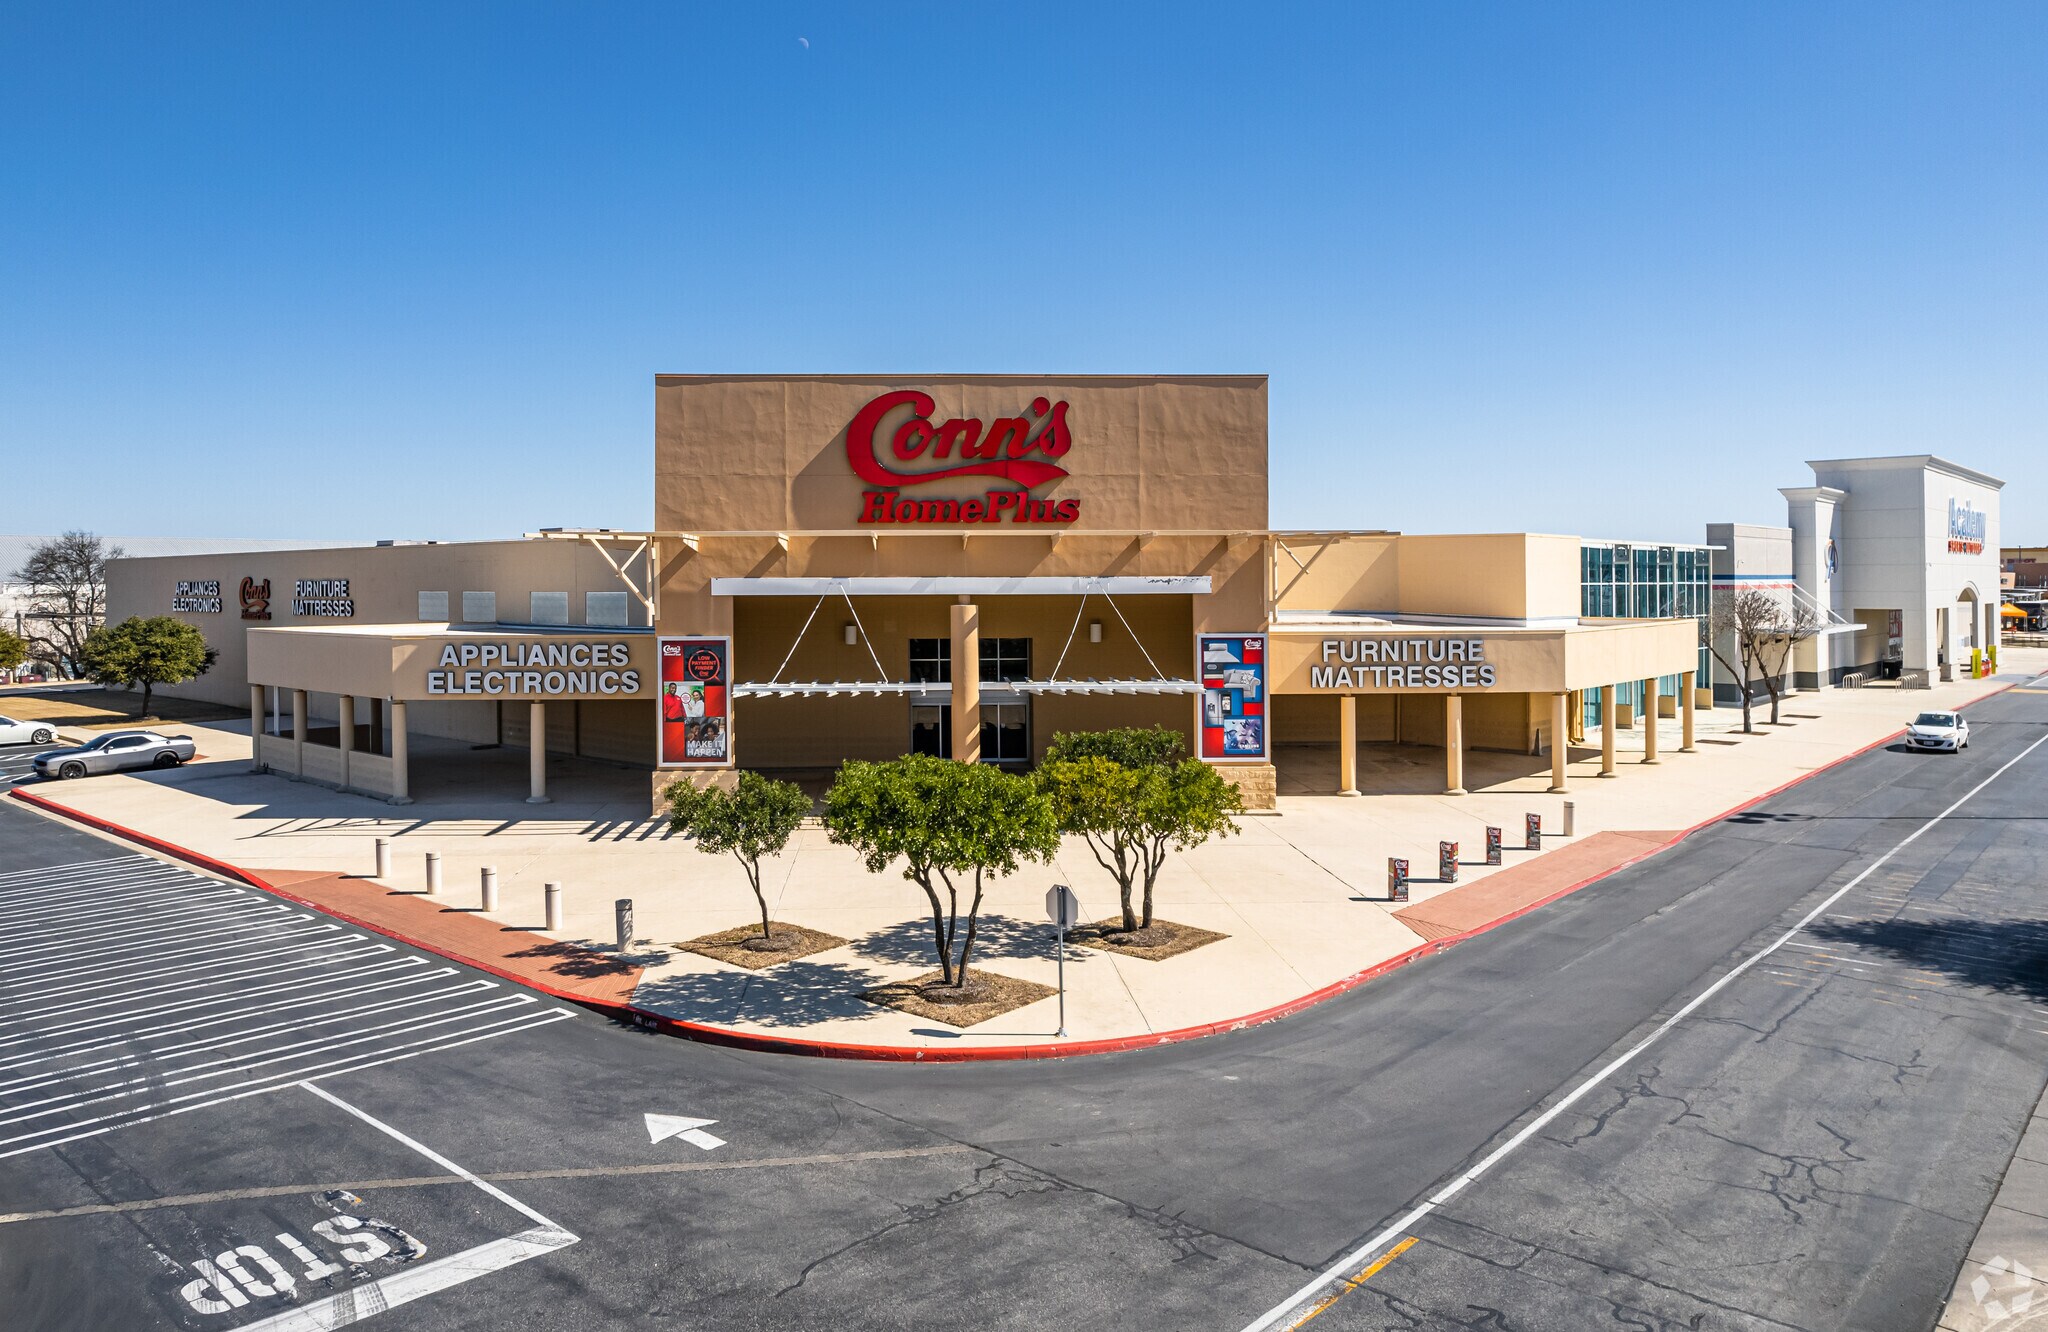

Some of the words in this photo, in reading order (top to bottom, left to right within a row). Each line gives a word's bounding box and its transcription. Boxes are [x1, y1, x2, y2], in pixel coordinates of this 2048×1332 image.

[846, 390, 1071, 488] Conn's
[857, 491, 1080, 523] HomePlus
[1947, 497, 1986, 550] Academy
[175, 581, 219, 596] APPLIANCES
[239, 576, 270, 611] Conn's
[295, 580, 348, 597] FURNITURE
[172, 598, 221, 613] ELECTRONICS
[291, 600, 353, 617] MATTRESSES
[439, 644, 630, 667] APPLIANCES
[1322, 640, 1485, 663] FURNITURE
[427, 671, 641, 695] ELECTRONICS
[1311, 665, 1498, 689] MATTRESSES
[687, 740, 713, 749] MAKE
[714, 740, 724, 749] IT
[687, 748, 723, 757] HAPPEN
[180, 1214, 392, 1315] STOP
